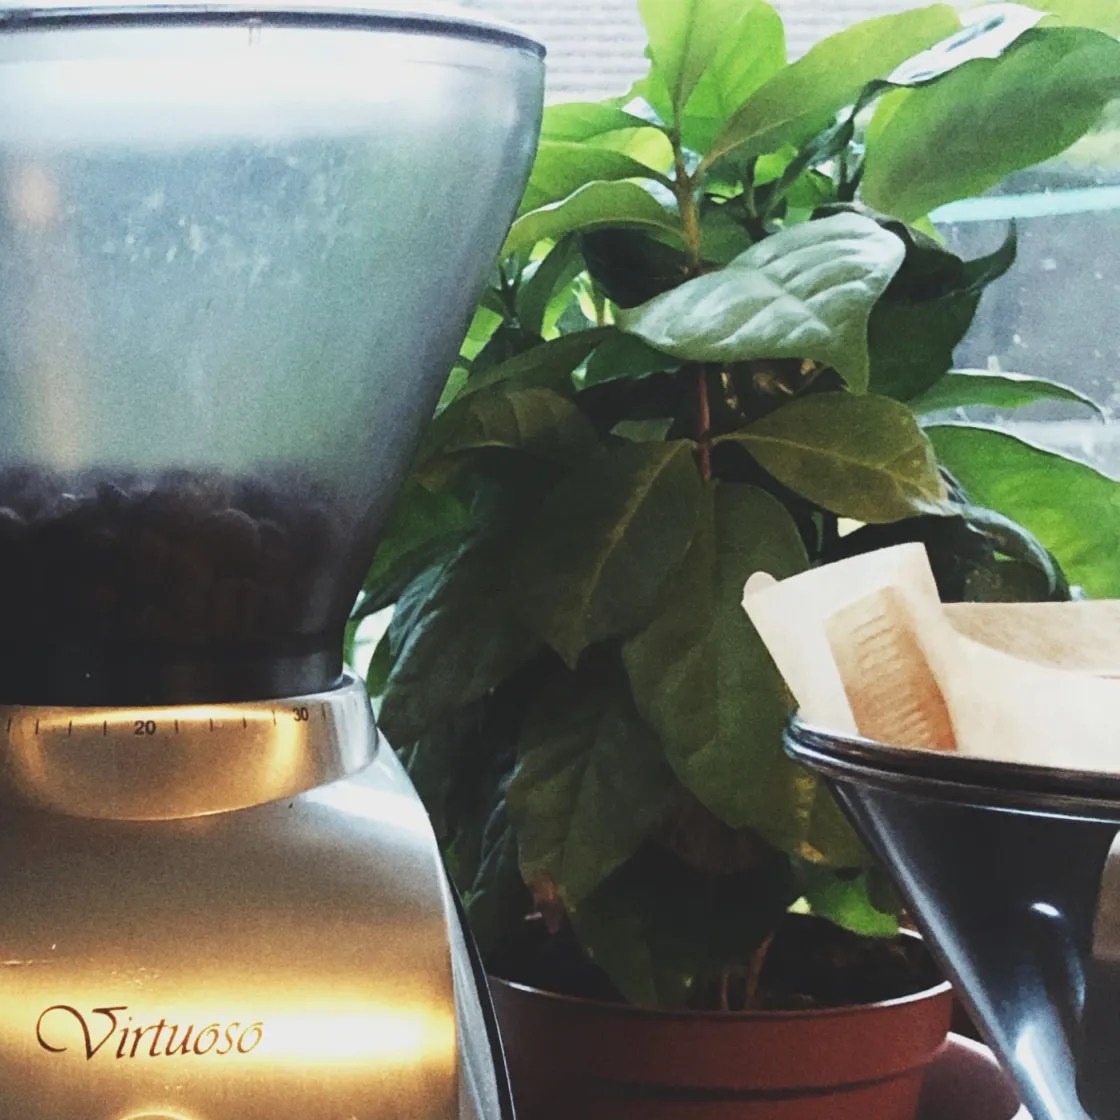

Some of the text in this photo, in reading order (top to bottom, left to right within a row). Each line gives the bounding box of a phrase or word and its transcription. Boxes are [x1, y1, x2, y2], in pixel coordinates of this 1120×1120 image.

[134, 720, 157, 735] 20
[292, 706, 309, 722] 30
[36, 1004, 264, 1061] Virtuoso
